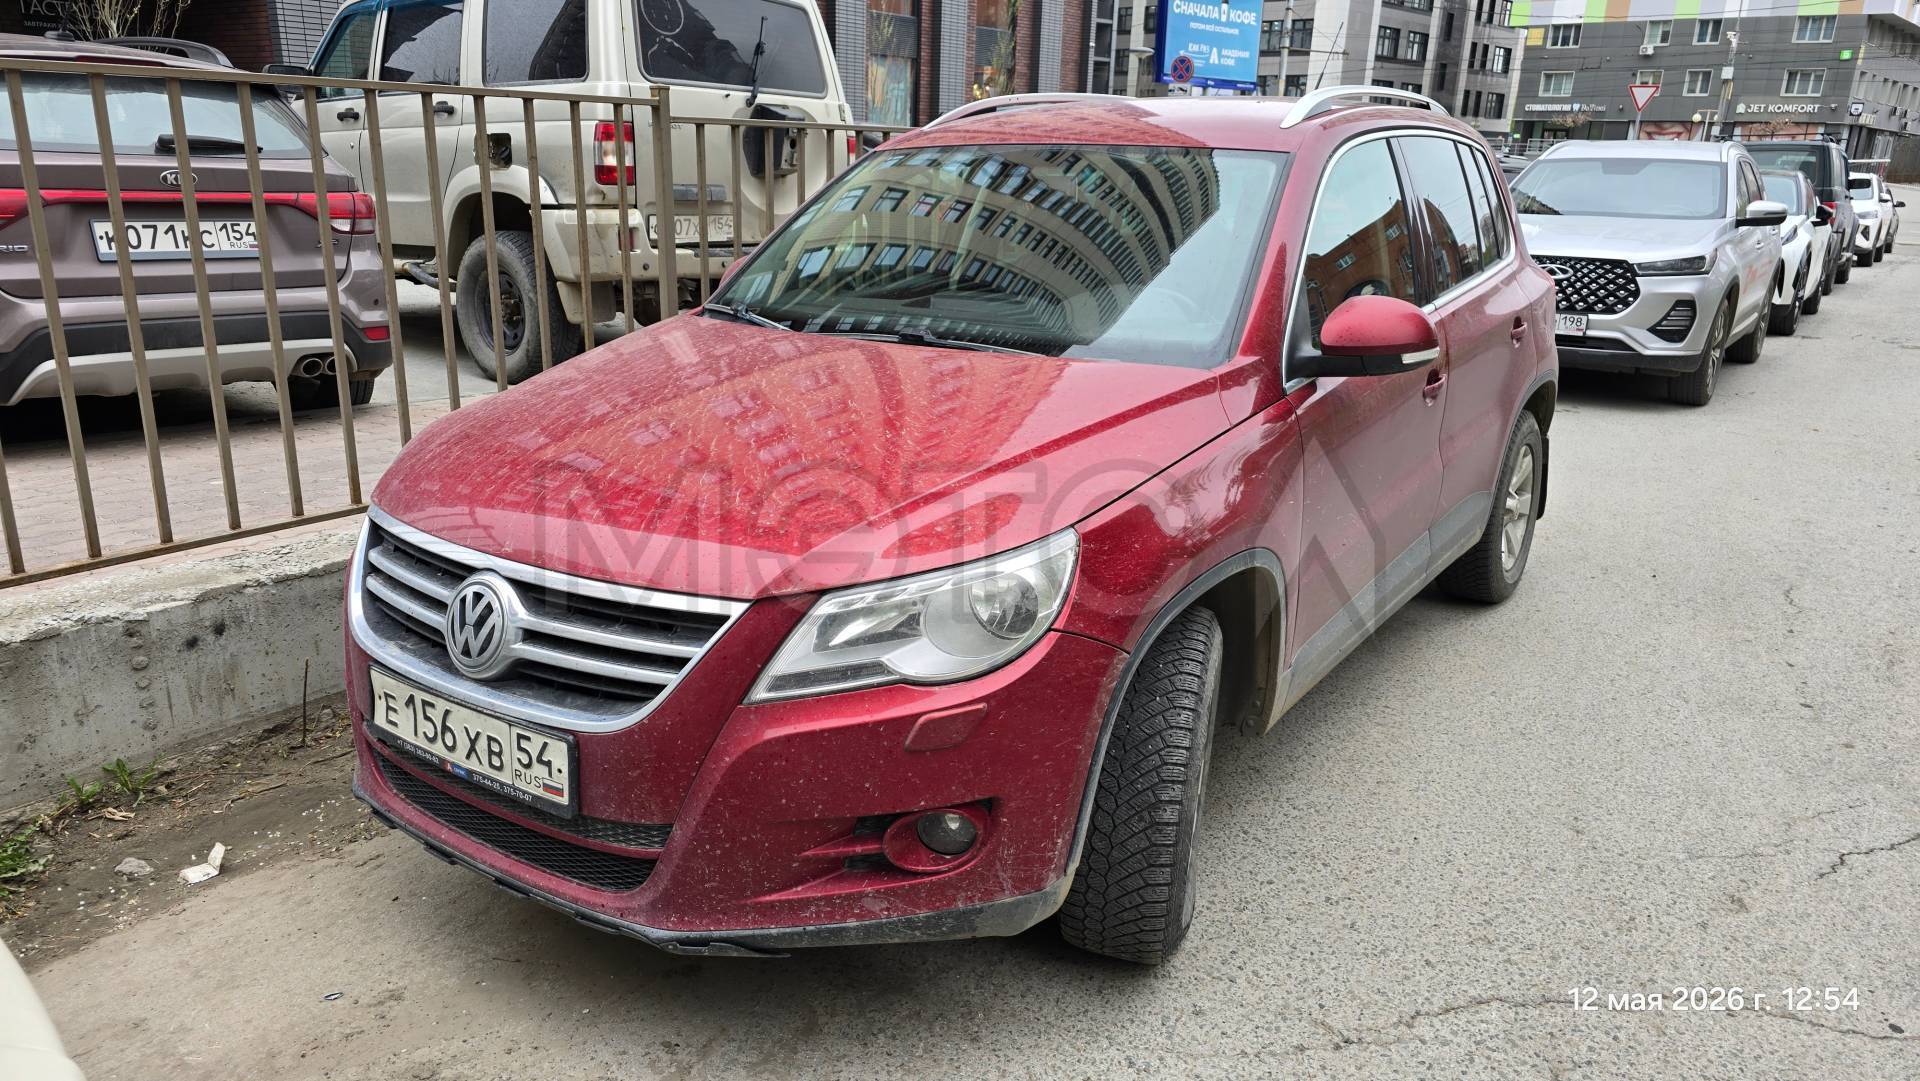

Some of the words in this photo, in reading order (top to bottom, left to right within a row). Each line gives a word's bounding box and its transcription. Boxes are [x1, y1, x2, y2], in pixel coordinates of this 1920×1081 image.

[1173, 0, 1219, 20] СНАЧАЛА
[1230, 9, 1257, 25] КОФЕ
[1747, 104, 1766, 113] JET
[1768, 104, 1820, 113] KOMFORT
[1562, 315, 1582, 327] 198
[384, 692, 504, 772] Е156ХВ
[516, 732, 553, 778] 54
[515, 769, 542, 788] RUS
